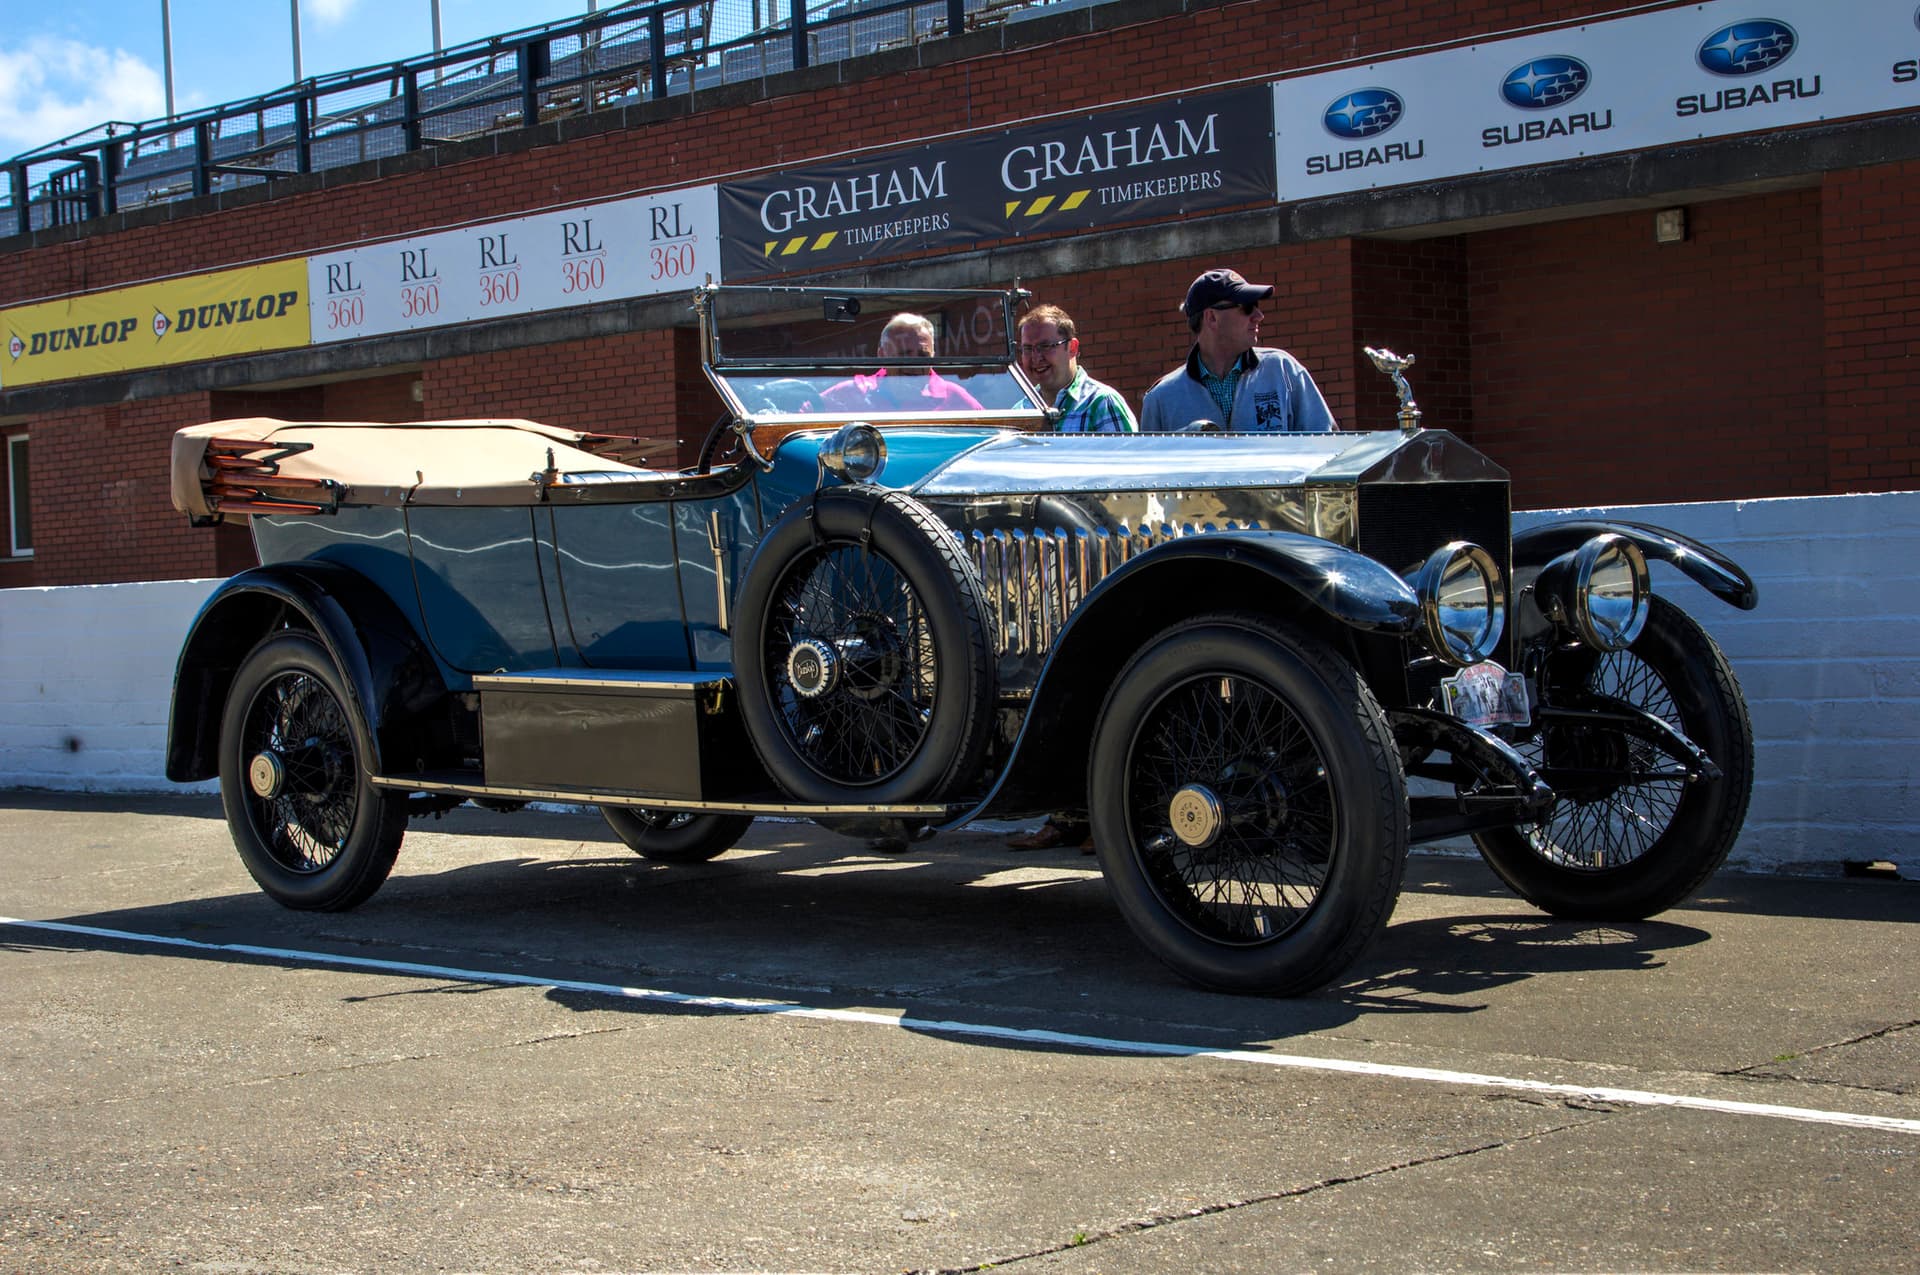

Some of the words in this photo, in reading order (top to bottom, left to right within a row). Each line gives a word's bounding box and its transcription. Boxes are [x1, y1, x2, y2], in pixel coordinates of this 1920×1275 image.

[1675, 74, 1821, 117] SUBARU
[1481, 108, 1613, 148] SUBARU
[1001, 113, 1220, 192] GRAHAM
[1305, 139, 1424, 175] SUBARU
[760, 160, 949, 234] GRAHAM
[1098, 169, 1222, 205] TIMEKEEPERS
[561, 218, 603, 256] RL
[649, 203, 693, 241] RL
[843, 212, 950, 246] TIMEKEEPERS
[400, 248, 438, 282] RL
[478, 233, 518, 269] RL
[326, 261, 362, 294] RL
[175, 290, 298, 333] DUNLOP
[28, 318, 138, 356] DUNLOP
